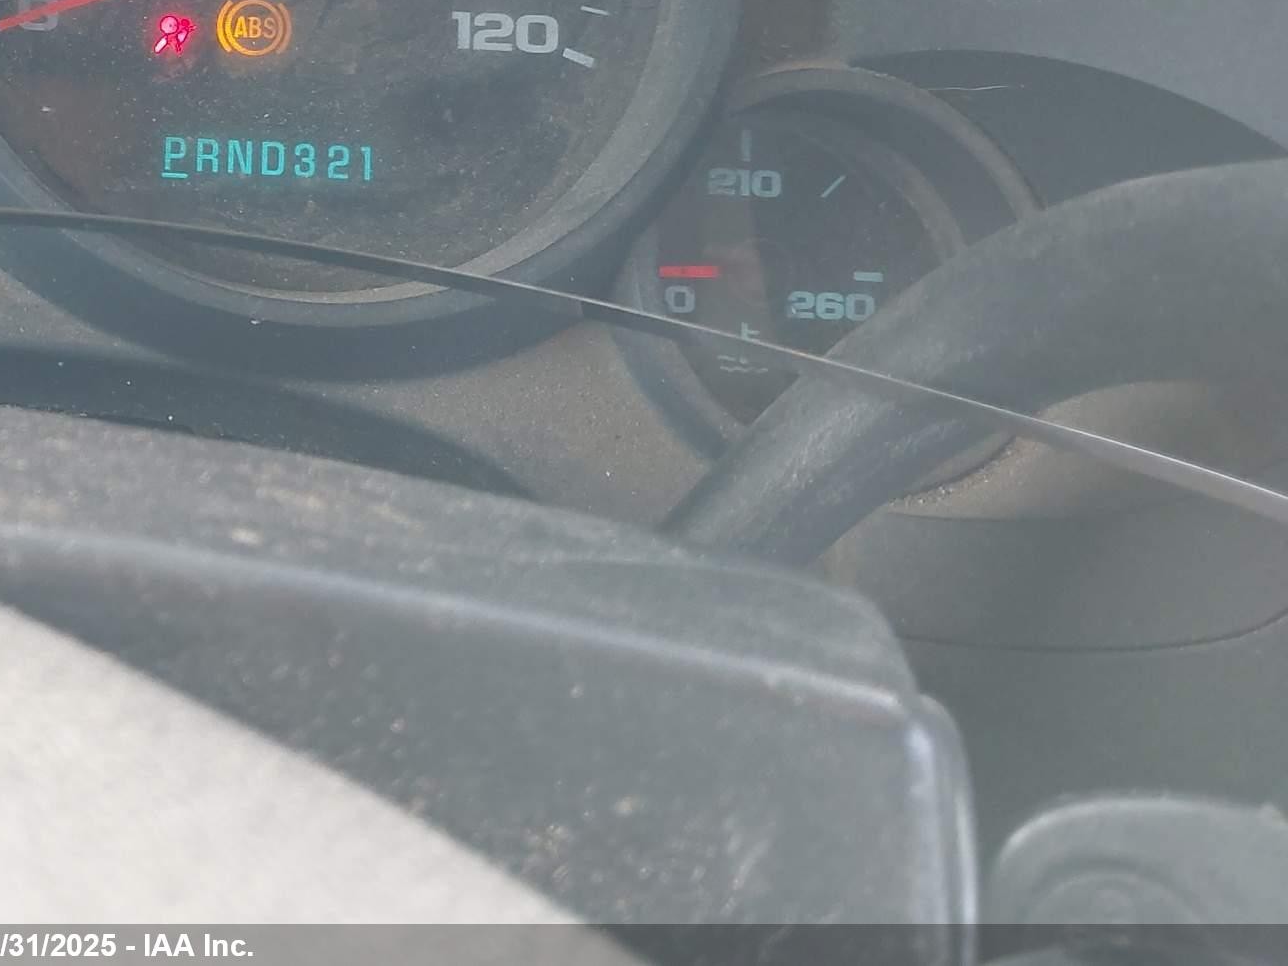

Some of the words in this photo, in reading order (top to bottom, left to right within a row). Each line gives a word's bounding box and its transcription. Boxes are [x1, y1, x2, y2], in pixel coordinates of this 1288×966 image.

[233, 16, 277, 39] ABS
[451, 12, 559, 53] 120
[707, 168, 782, 198] 210
[665, 286, 696, 314] 0
[786, 291, 876, 321] 260
